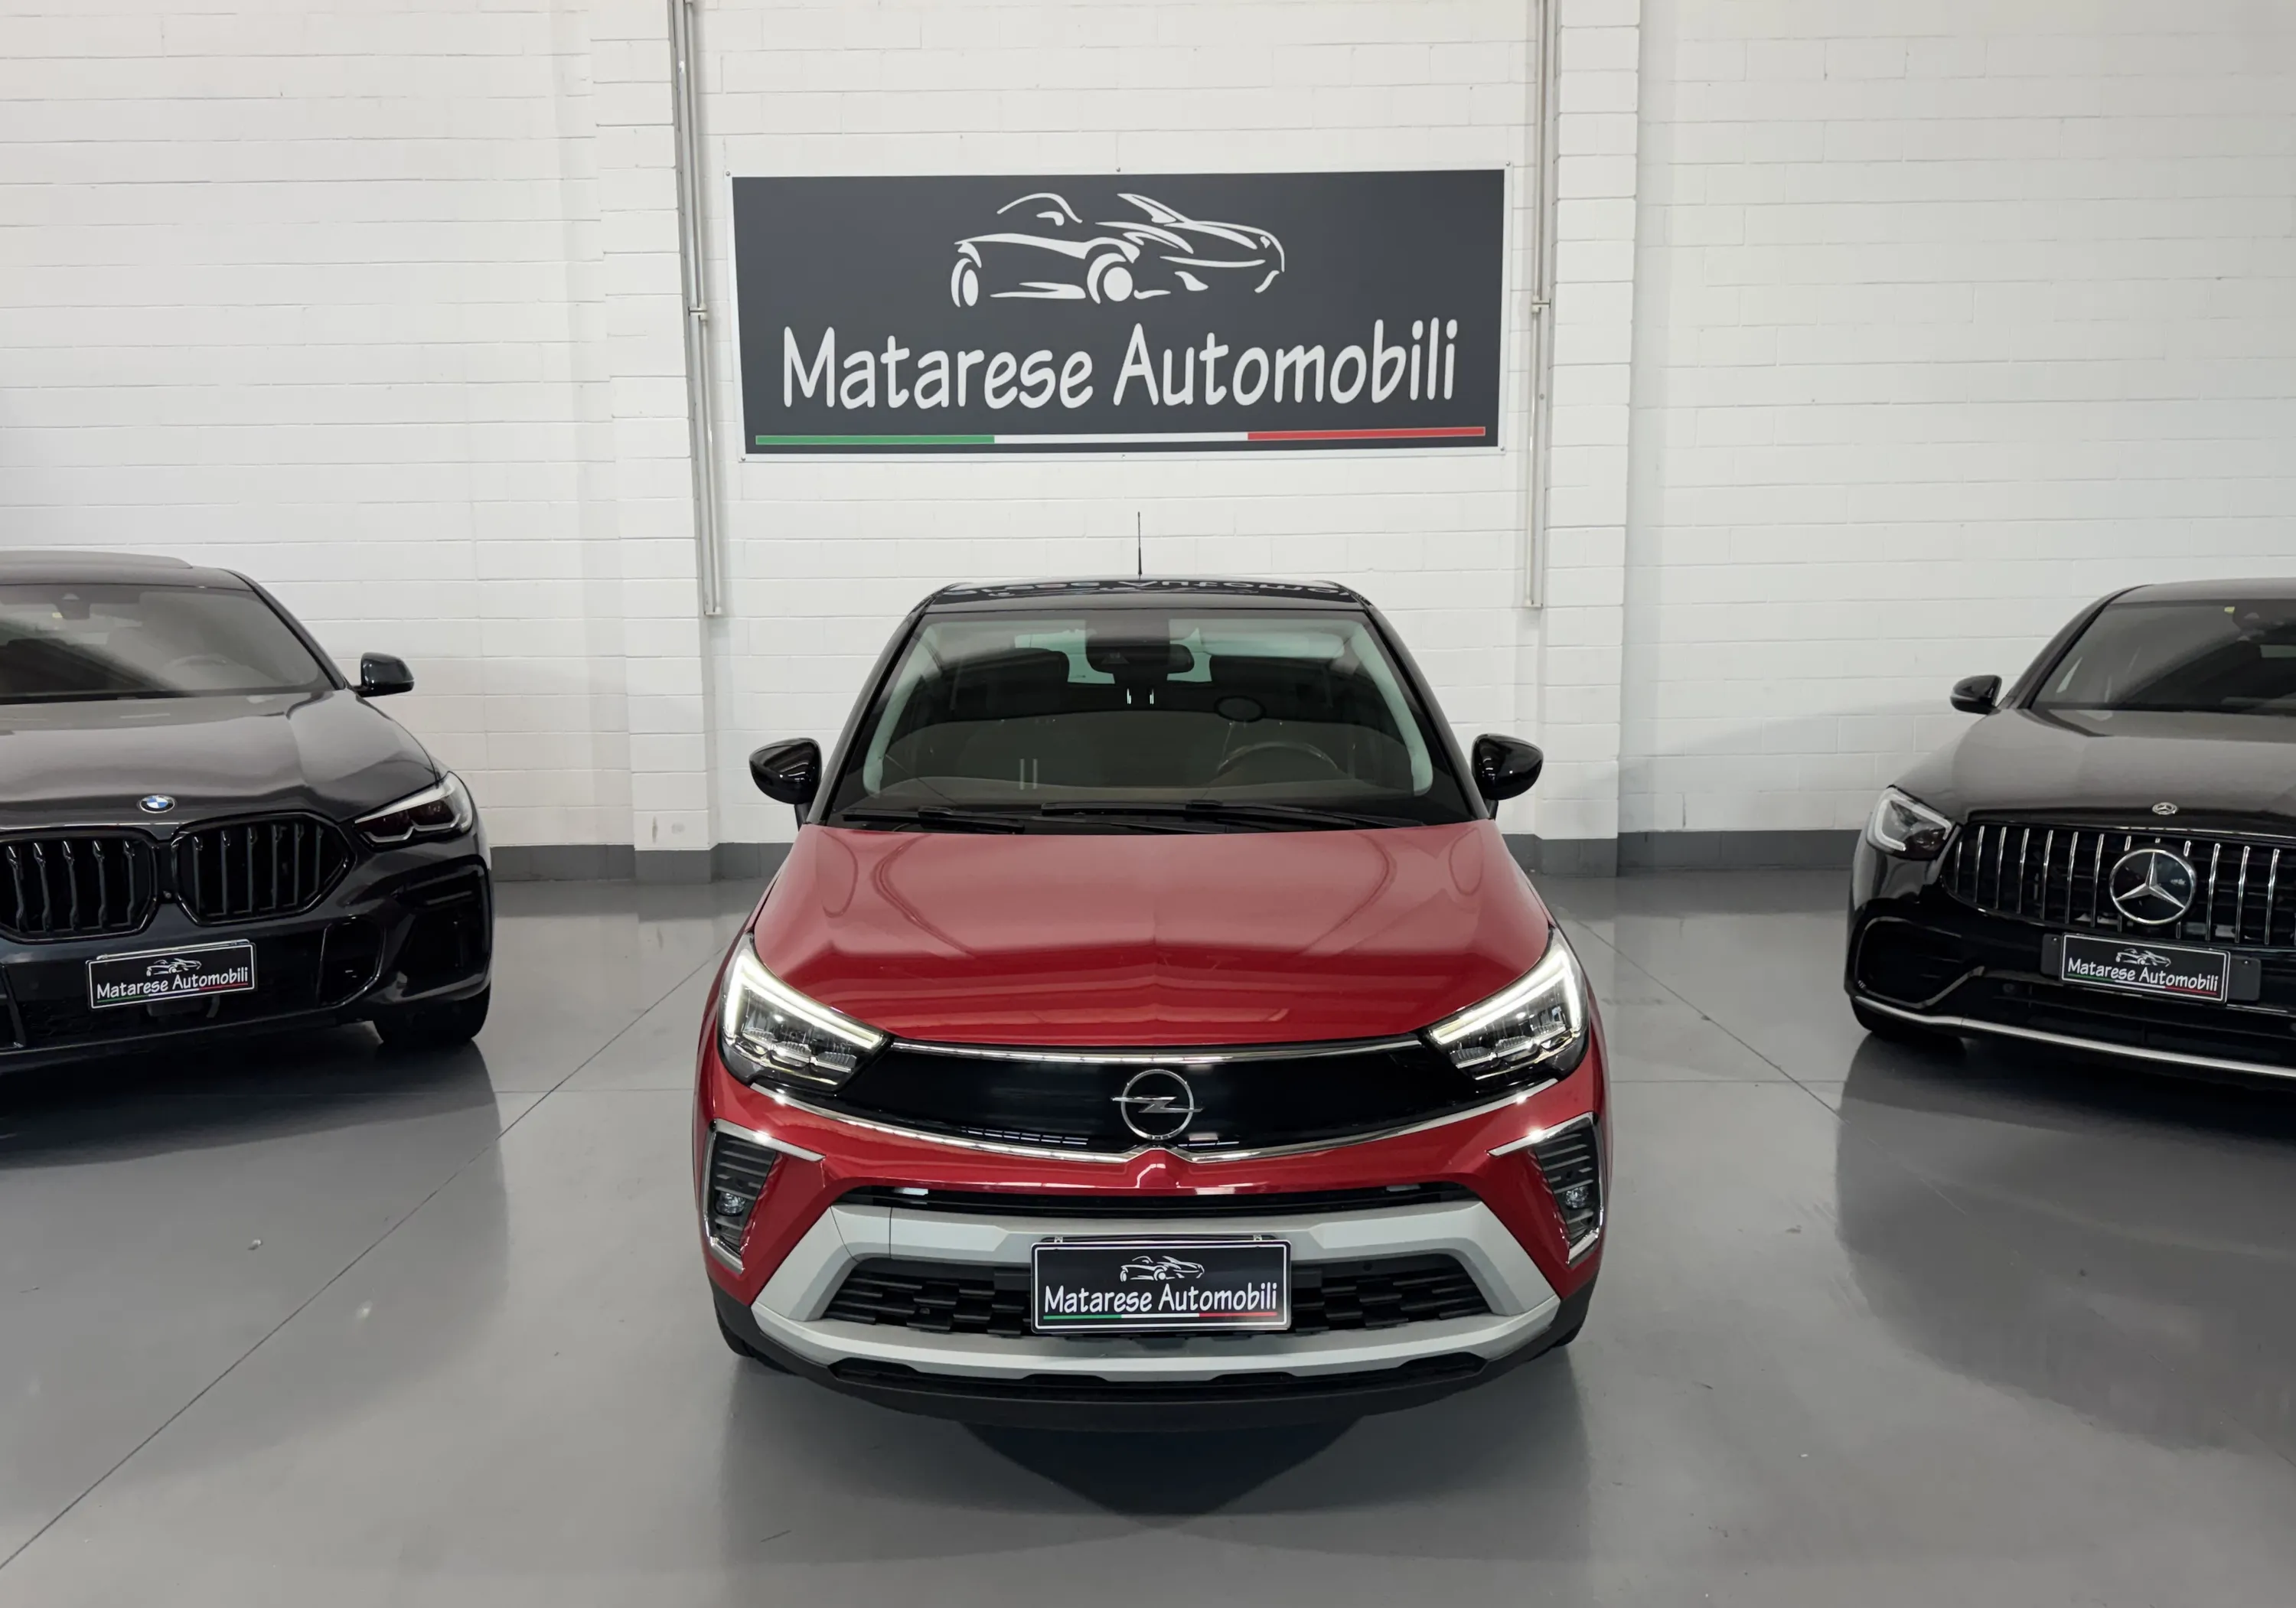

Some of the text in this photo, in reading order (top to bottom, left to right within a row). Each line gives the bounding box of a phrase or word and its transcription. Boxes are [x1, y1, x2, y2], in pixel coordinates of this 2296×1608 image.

[784, 318, 1458, 409] Matarese Automobili
[97, 967, 248, 1000] Matarese Automobili
[2068, 957, 2219, 991] Matarese Automobili
[1045, 1282, 1277, 1313] Matarese Automobili
